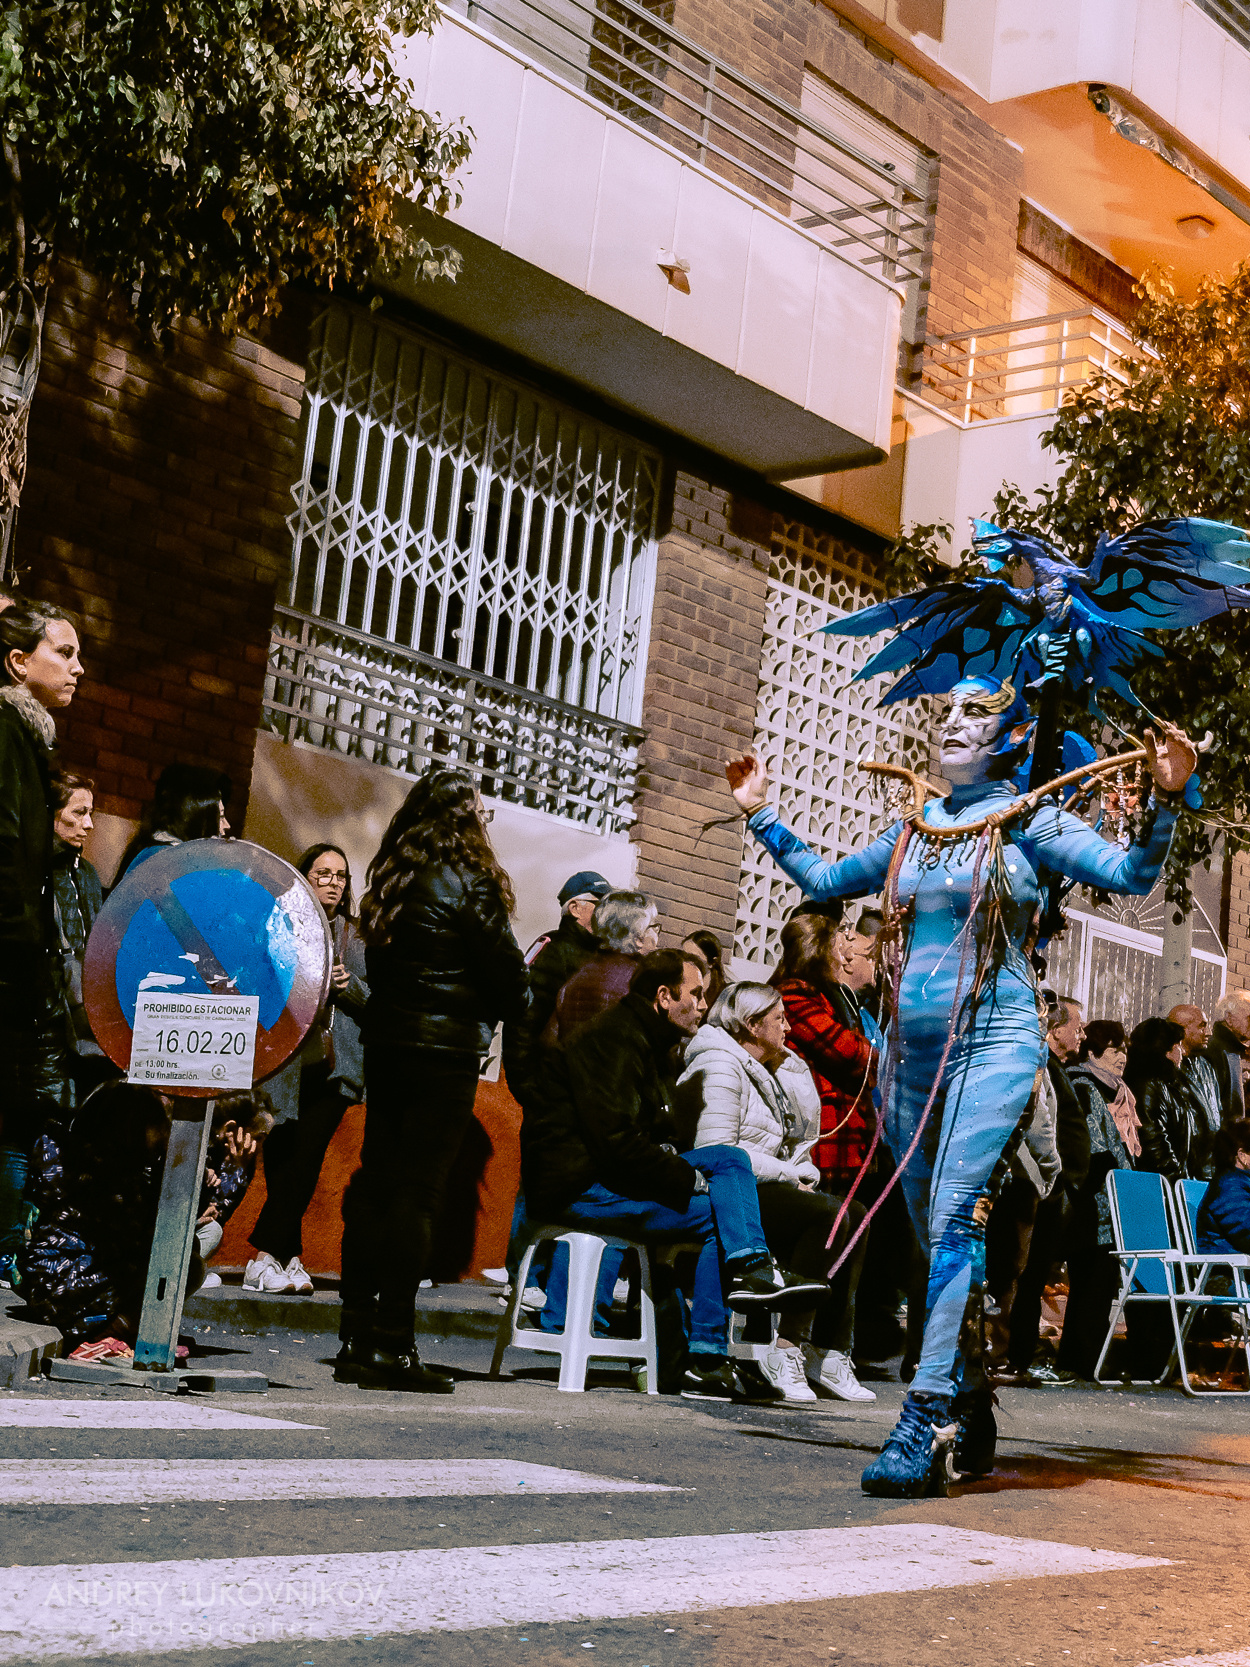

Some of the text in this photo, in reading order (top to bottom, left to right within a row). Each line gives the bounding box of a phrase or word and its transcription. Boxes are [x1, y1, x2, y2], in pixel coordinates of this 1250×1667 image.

[143, 1003, 251, 1016] PROHIBIDO ESTACIONAR
[155, 1029, 246, 1056] 16.02.20
[166, 1060, 180, 1069] hrs.
[145, 1070, 155, 1079] Su
